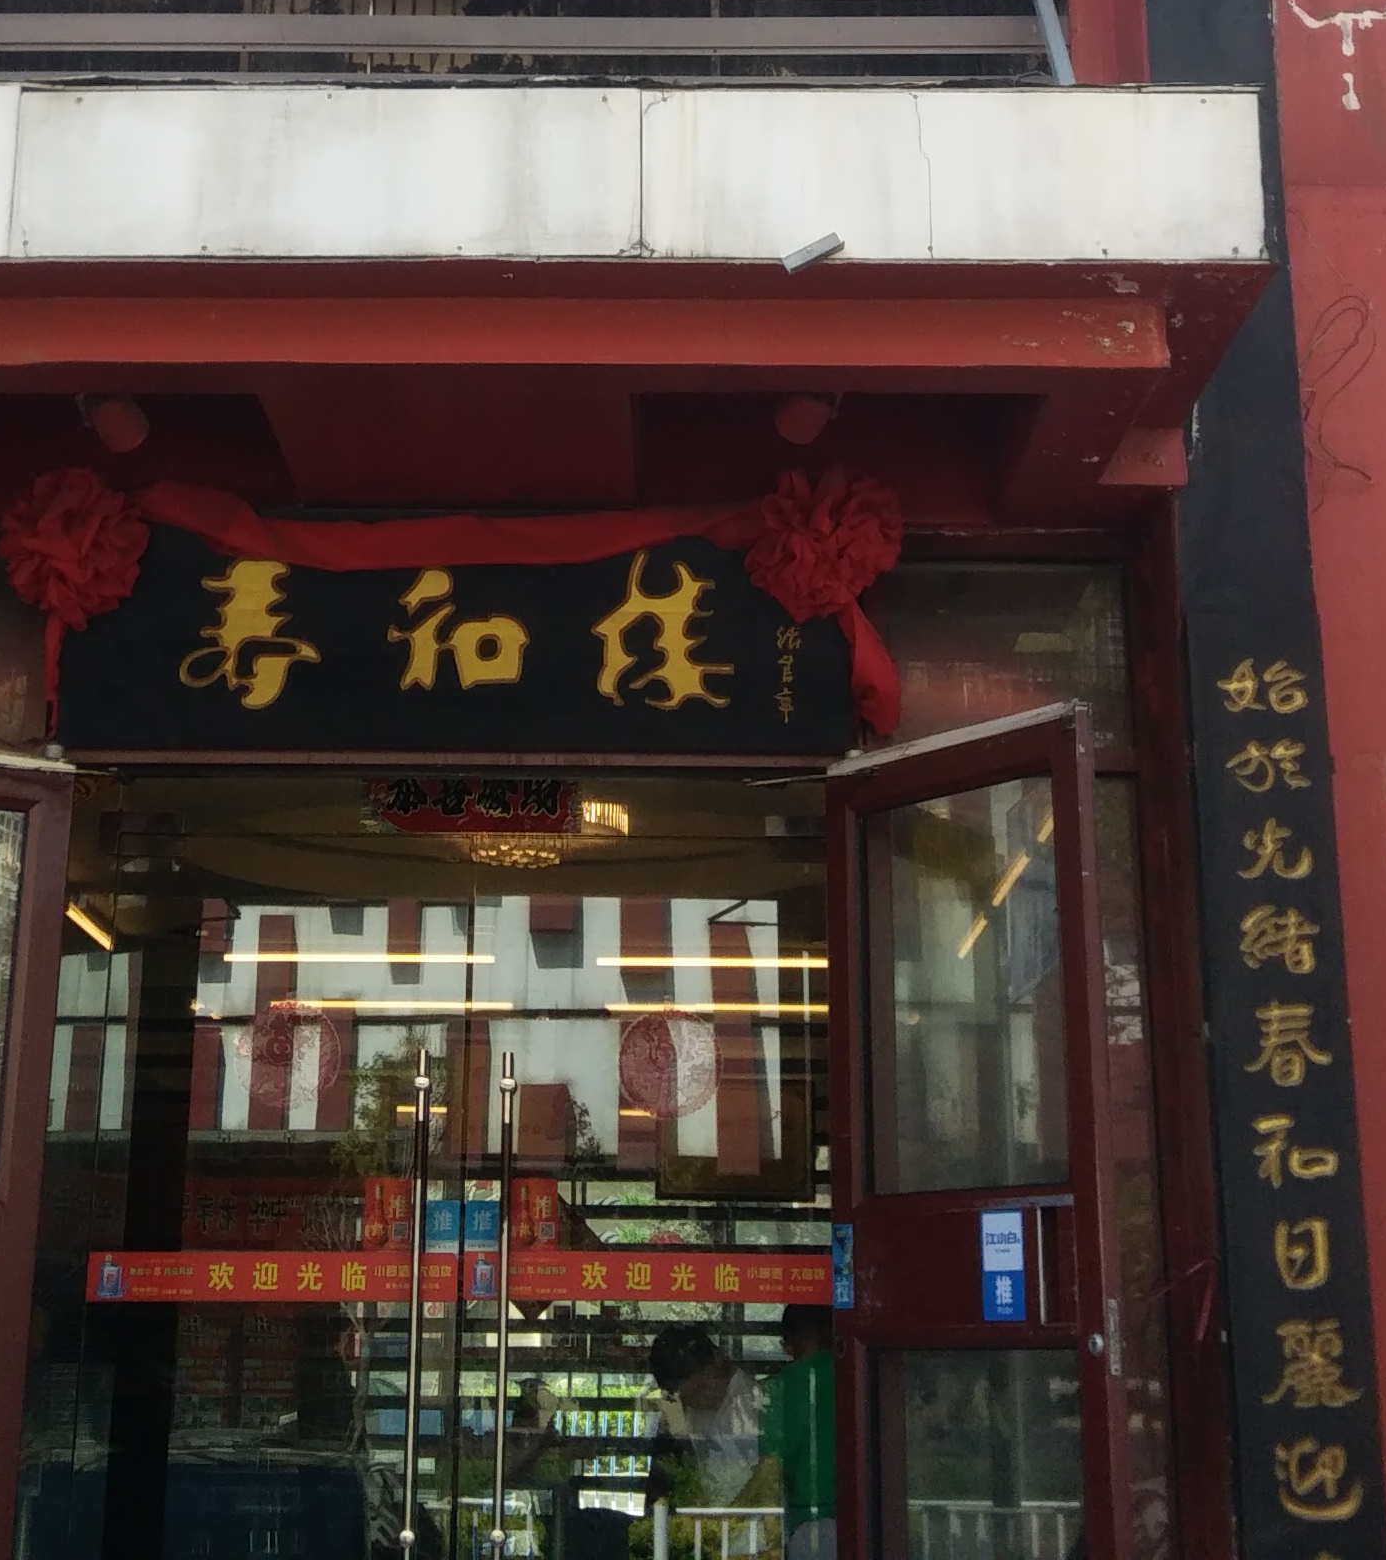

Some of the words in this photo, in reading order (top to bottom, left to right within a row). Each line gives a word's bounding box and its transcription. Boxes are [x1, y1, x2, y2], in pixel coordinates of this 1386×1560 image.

[433, 1209, 454, 1232] 推
[472, 1209, 493, 1232] 推
[208, 1261, 368, 1292] 欢迎光临
[581, 1261, 741, 1293] 欢迎光临
[995, 1274, 1014, 1306] 推
